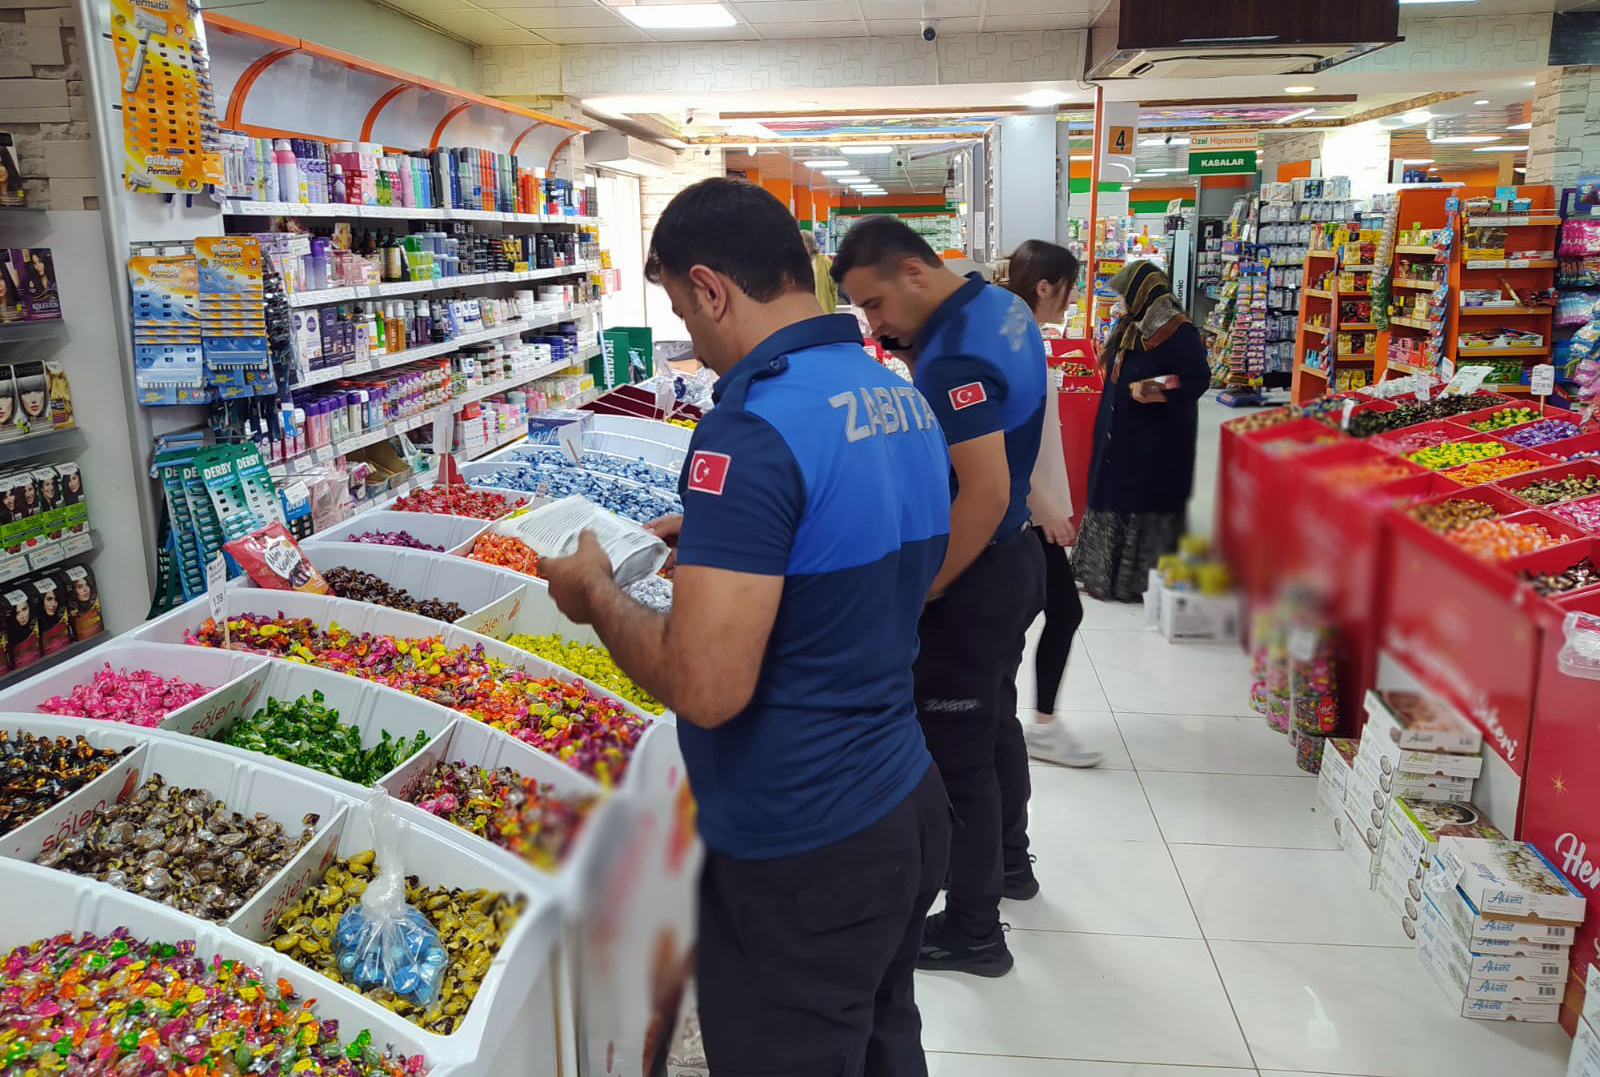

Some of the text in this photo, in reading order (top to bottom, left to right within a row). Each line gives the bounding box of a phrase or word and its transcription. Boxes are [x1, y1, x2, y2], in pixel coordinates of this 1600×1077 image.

[128, 0, 169, 10] ermatik
[1115, 130, 1125, 150] 4
[1210, 136, 1257, 145] Hipermarket
[1200, 158, 1245, 167] KASALAR
[147, 165, 182, 175] Permatik
[828, 387, 939, 443] ZABITA
[236, 452, 260, 470] DERBY
[203, 461, 232, 480] DERBY
